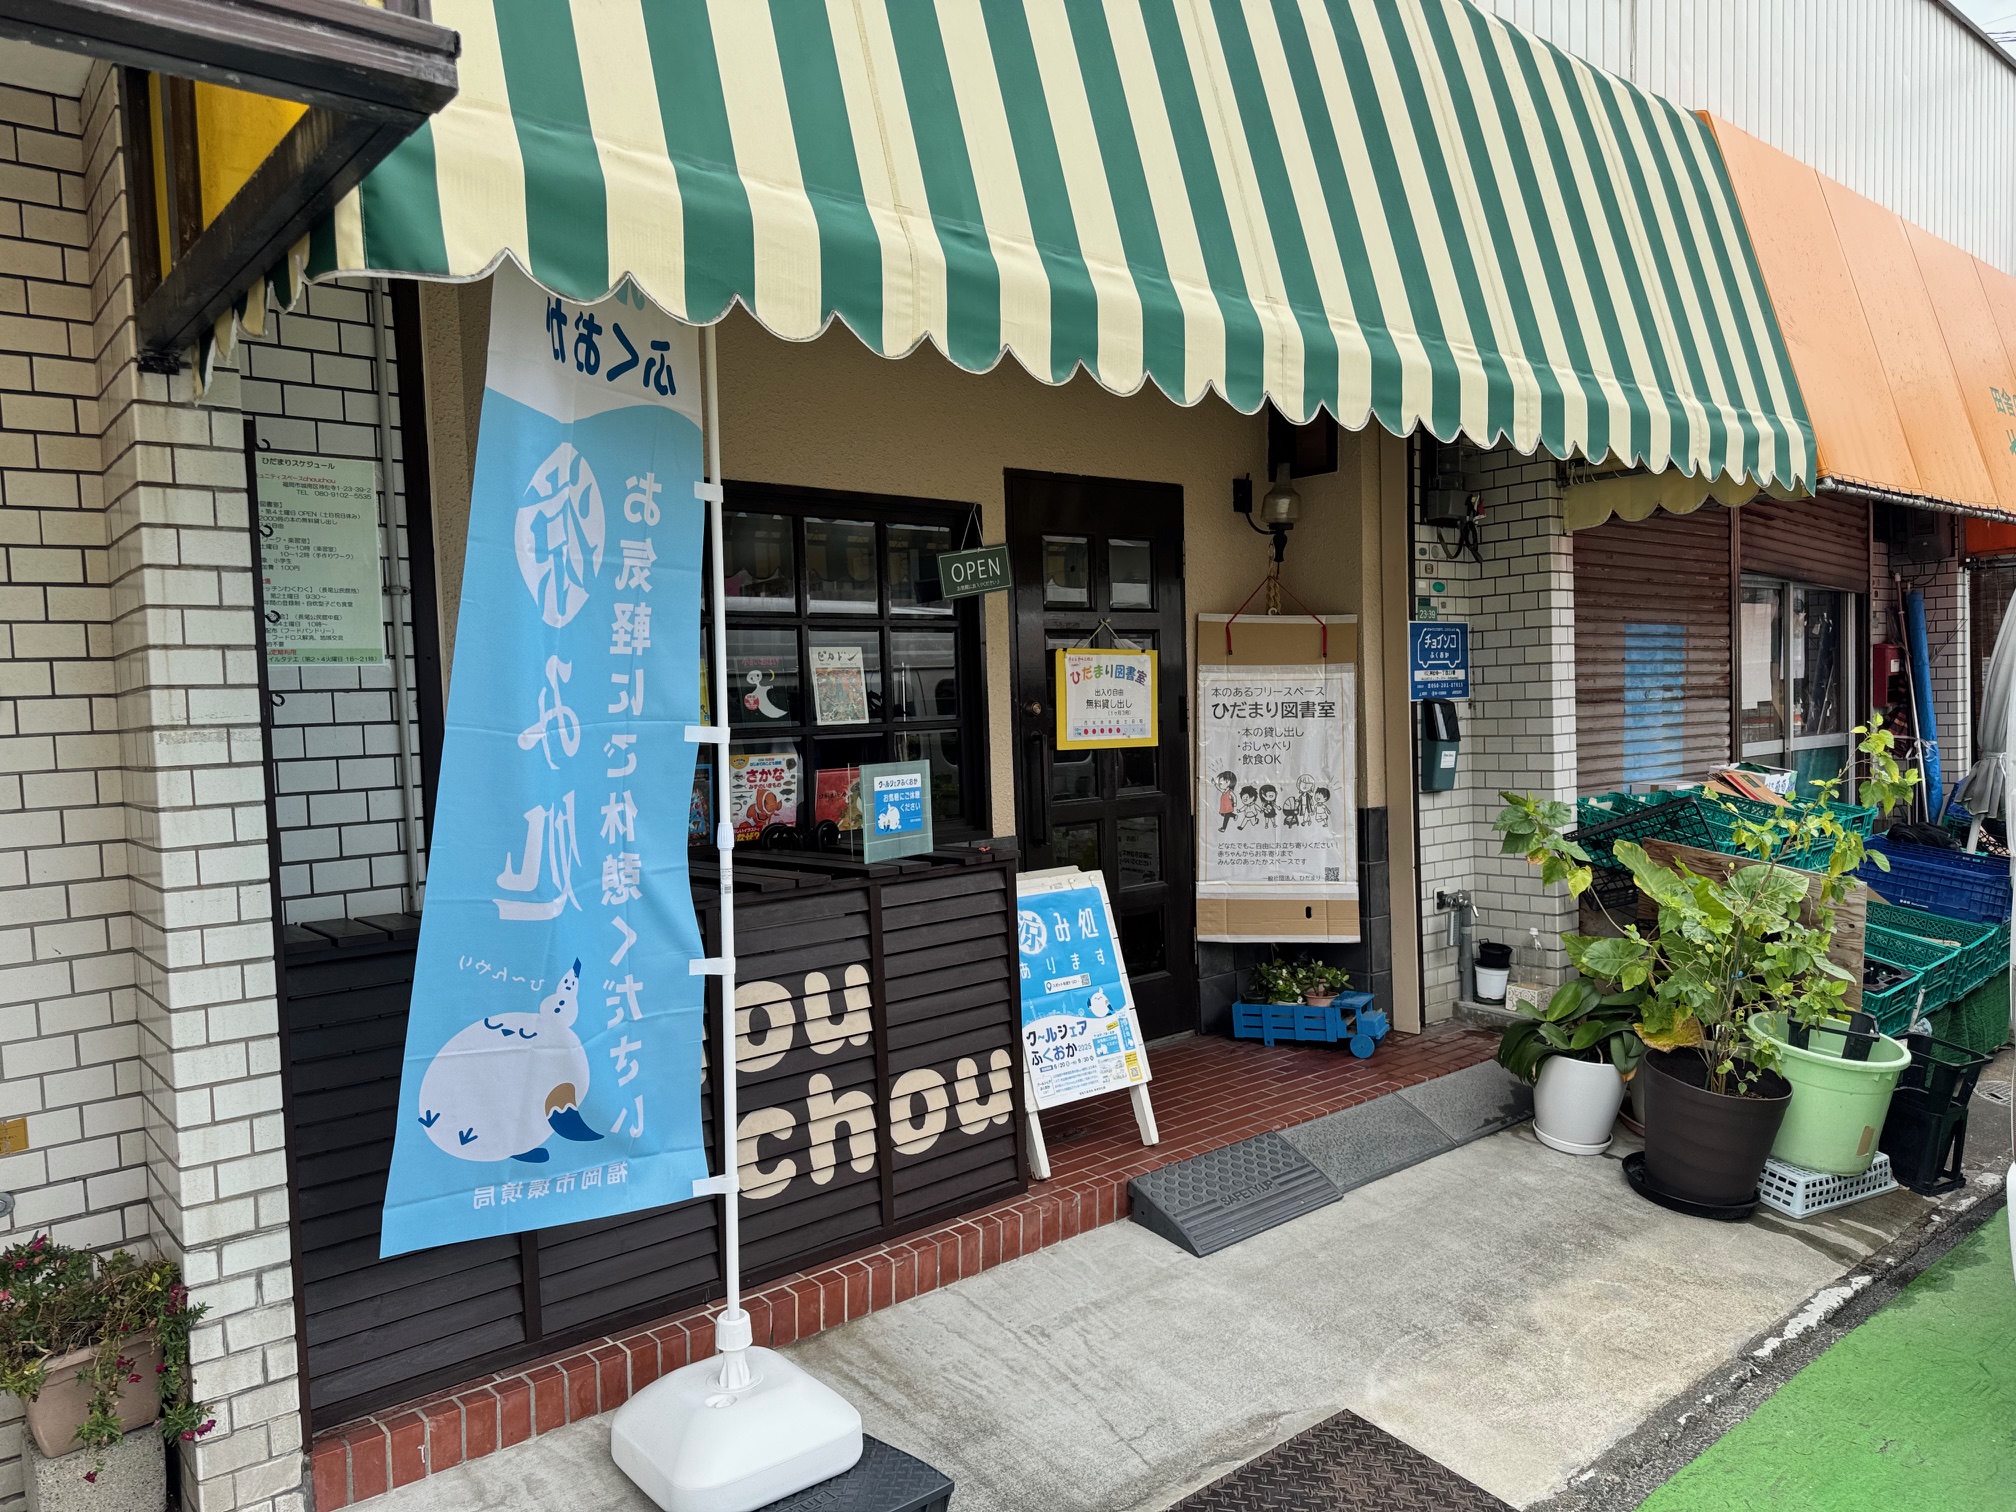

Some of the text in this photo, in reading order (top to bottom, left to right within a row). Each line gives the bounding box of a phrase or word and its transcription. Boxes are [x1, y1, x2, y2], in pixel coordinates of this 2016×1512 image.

[261, 457, 336, 470] ひだまりスケジュール
[951, 557, 1000, 583] OPEN
[1424, 634, 1457, 649] チョイソコ
[1070, 664, 1147, 687] ひだまり図書室
[1094, 688, 1124, 697] 出入り自由
[1211, 687, 1325, 698] 本のあるフリースペース
[1085, 699, 1133, 710] 無料貸し出し
[1212, 701, 1336, 719] ひだまり図書室
[746, 767, 785, 783] さかな
[878, 779, 918, 788] クールシェアふくおか
[883, 791, 921, 803] お気軽にご休憩
[900, 803, 921, 812] ください
[1218, 842, 1339, 850] どなたでもご自由にお立ち寄りください！
[1217, 850, 1294, 858] 赤ちゃんからお年寄りまで
[1217, 858, 1307, 866] みんなのあったかスペースです
[1018, 907, 1100, 955] 涼み処
[1020, 948, 1106, 980] あります
[1031, 1042, 1092, 1066] ふくおか 2025
[736, 1048, 1014, 1200] chou
